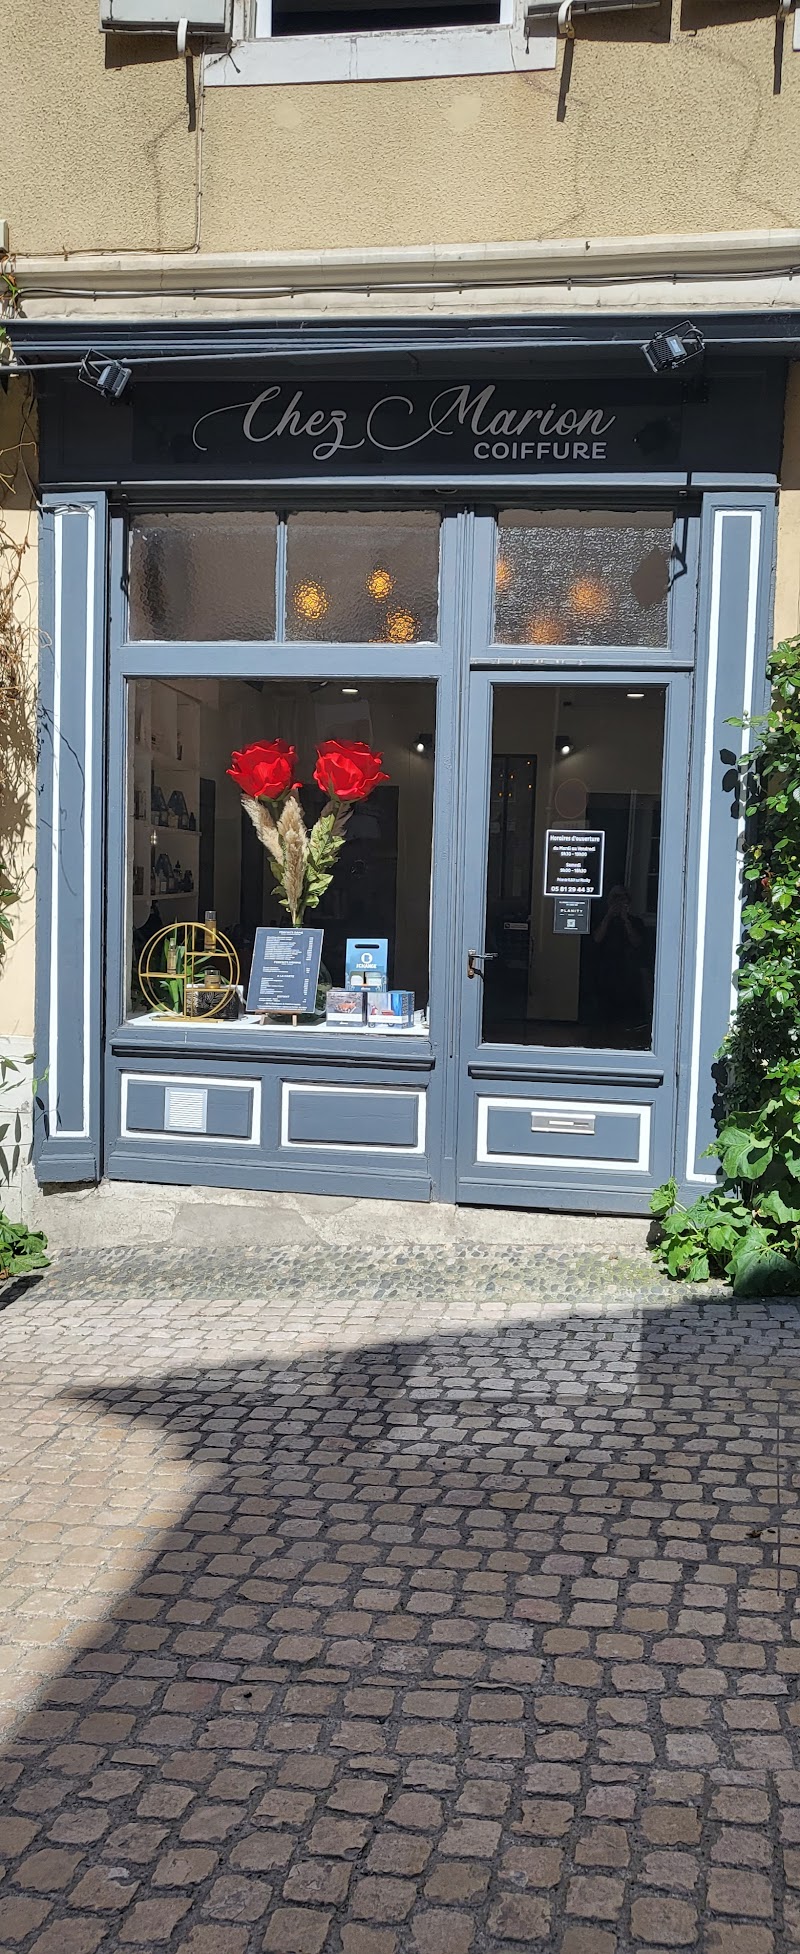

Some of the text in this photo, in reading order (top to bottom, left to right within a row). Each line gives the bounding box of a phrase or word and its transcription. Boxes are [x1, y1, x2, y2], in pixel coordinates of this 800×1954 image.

[193, 385, 616, 460] Chez Marion
[473, 441, 607, 460] COIFFURE
